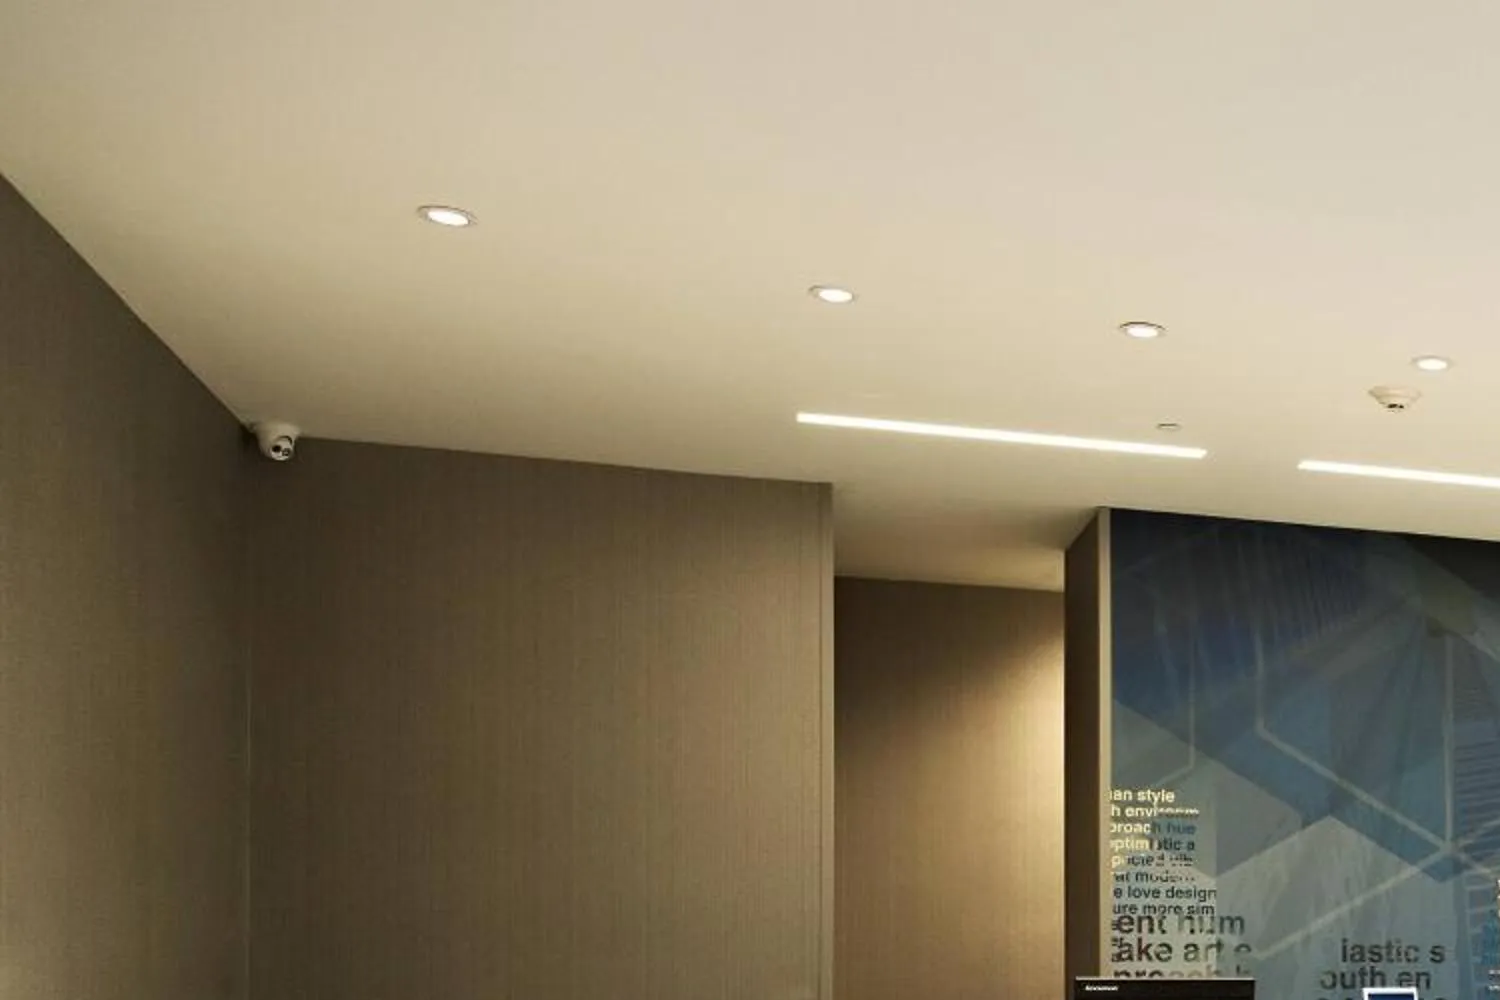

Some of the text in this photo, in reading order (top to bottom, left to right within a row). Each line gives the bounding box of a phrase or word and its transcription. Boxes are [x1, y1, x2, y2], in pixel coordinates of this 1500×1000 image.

[1137, 788, 1176, 806] style
[1128, 886, 1161, 899] love
[1166, 886, 1217, 903] design
[1429, 943, 1447, 965] s
